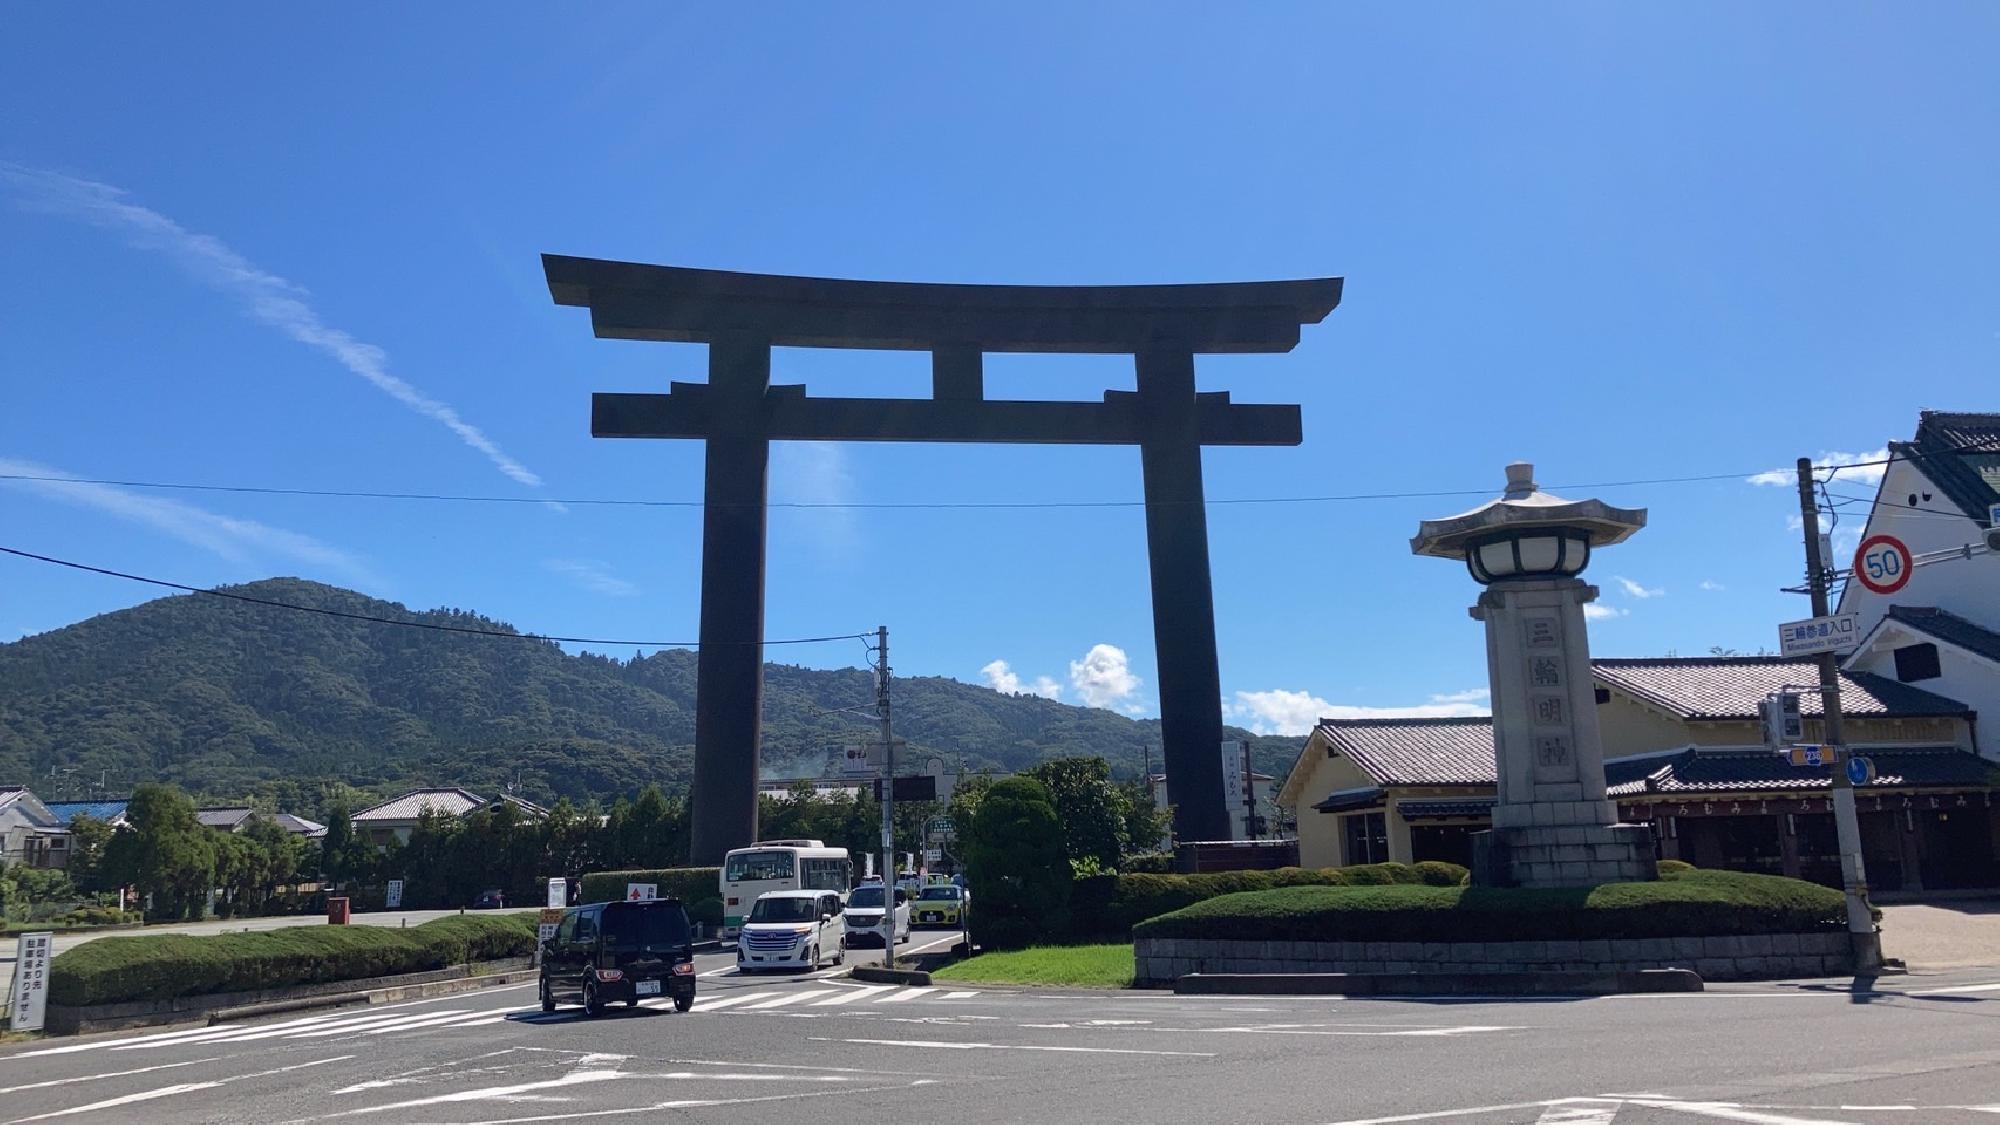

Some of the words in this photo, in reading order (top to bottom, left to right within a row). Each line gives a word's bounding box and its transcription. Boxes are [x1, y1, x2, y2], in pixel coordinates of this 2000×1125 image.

[1866, 549, 1900, 579] 50
[1783, 618, 1853, 643] 三輪参道入口
[1533, 622, 1566, 764] 三輪明神
